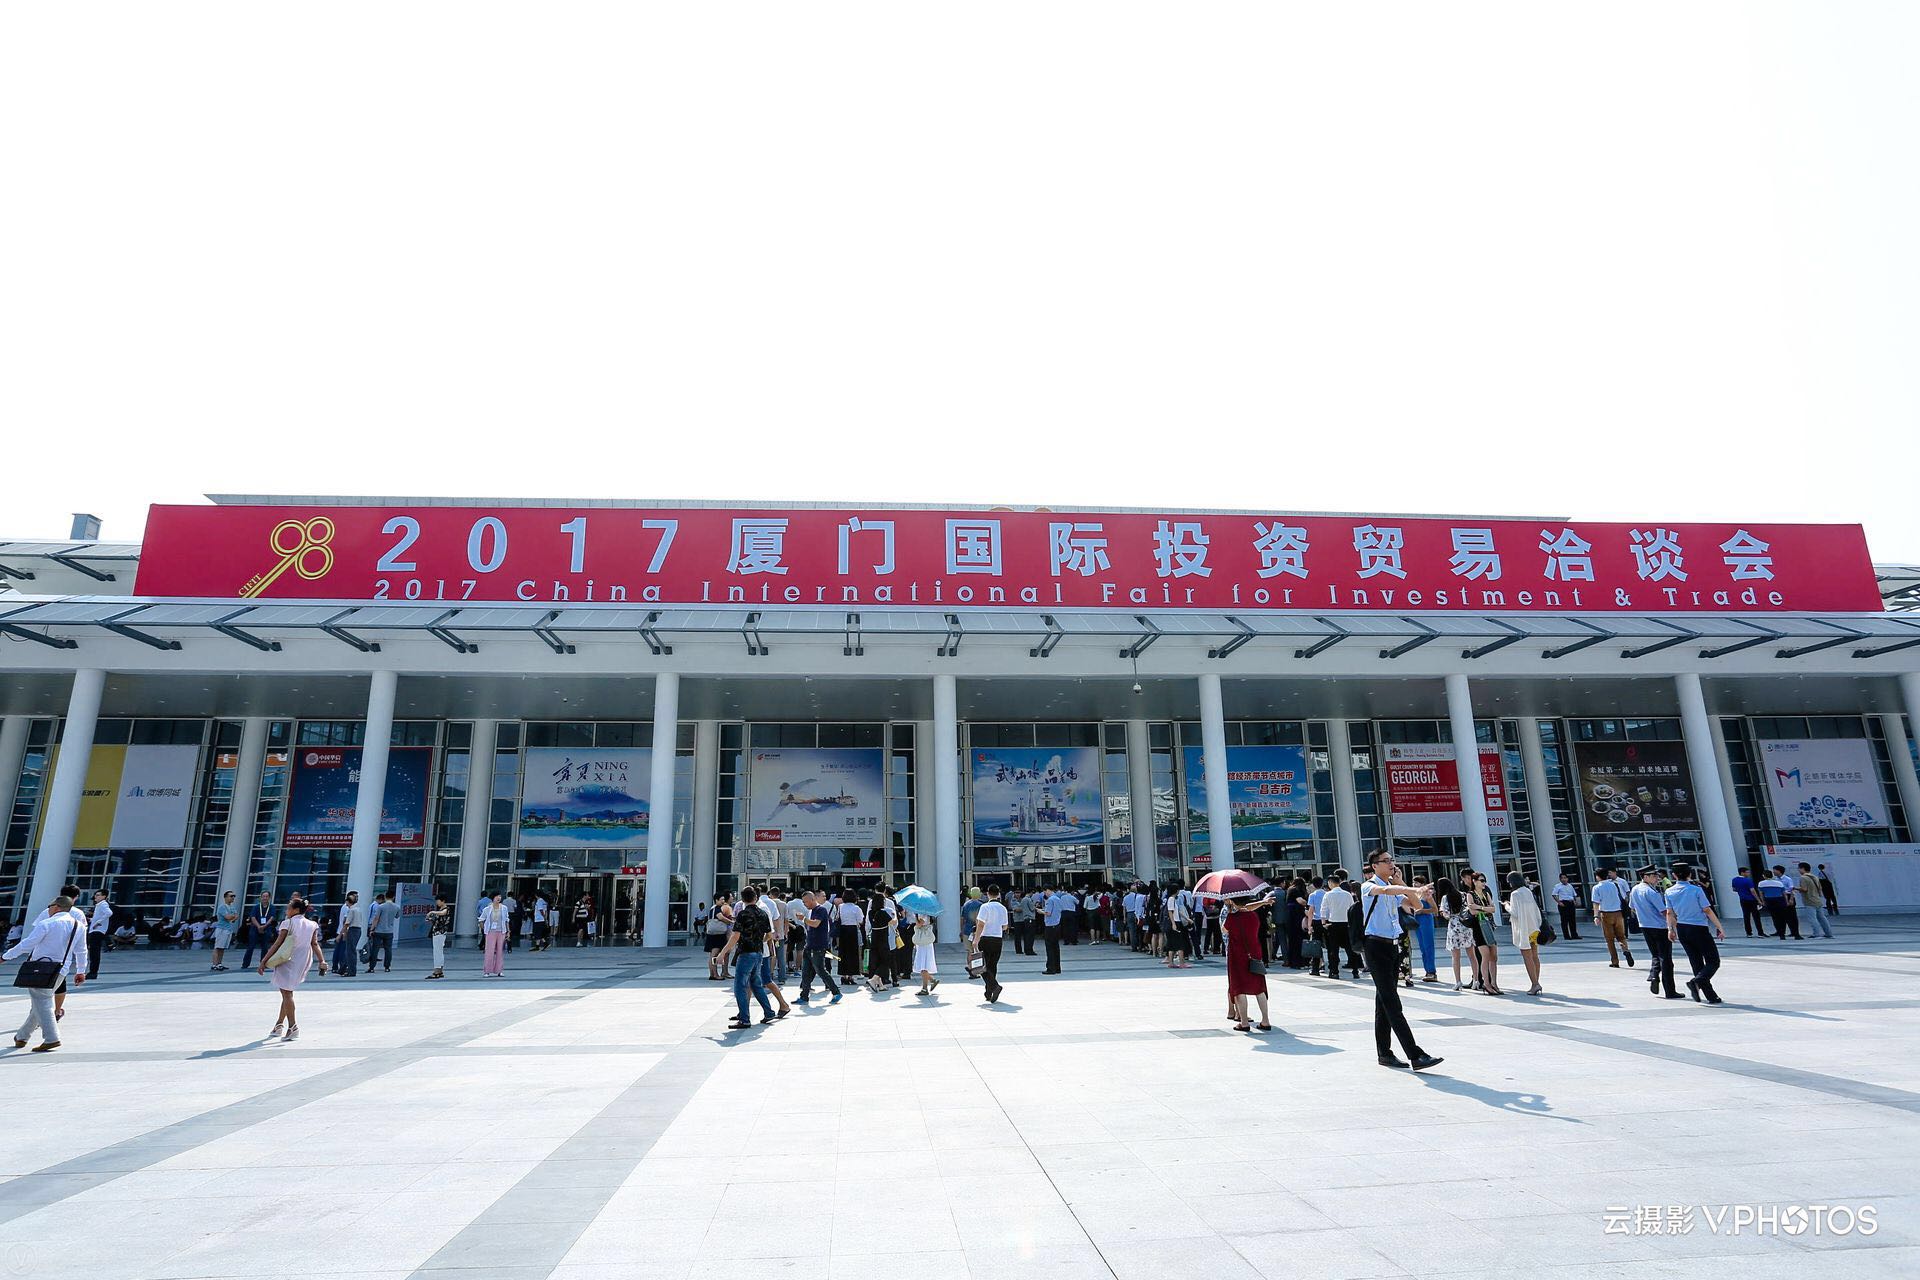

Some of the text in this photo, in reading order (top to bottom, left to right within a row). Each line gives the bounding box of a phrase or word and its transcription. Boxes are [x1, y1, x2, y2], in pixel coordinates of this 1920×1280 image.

[376, 515, 1775, 582] 2017厦门国际投资贸易洽谈会
[238, 573, 262, 597] CIFIT
[374, 579, 1783, 606] 2017 China International Fair for Investment & Trade
[594, 761, 628, 770] NING
[594, 772, 628, 781] XIA
[1391, 770, 1439, 784] GEORGIA
[1487, 817, 1505, 827] C328
